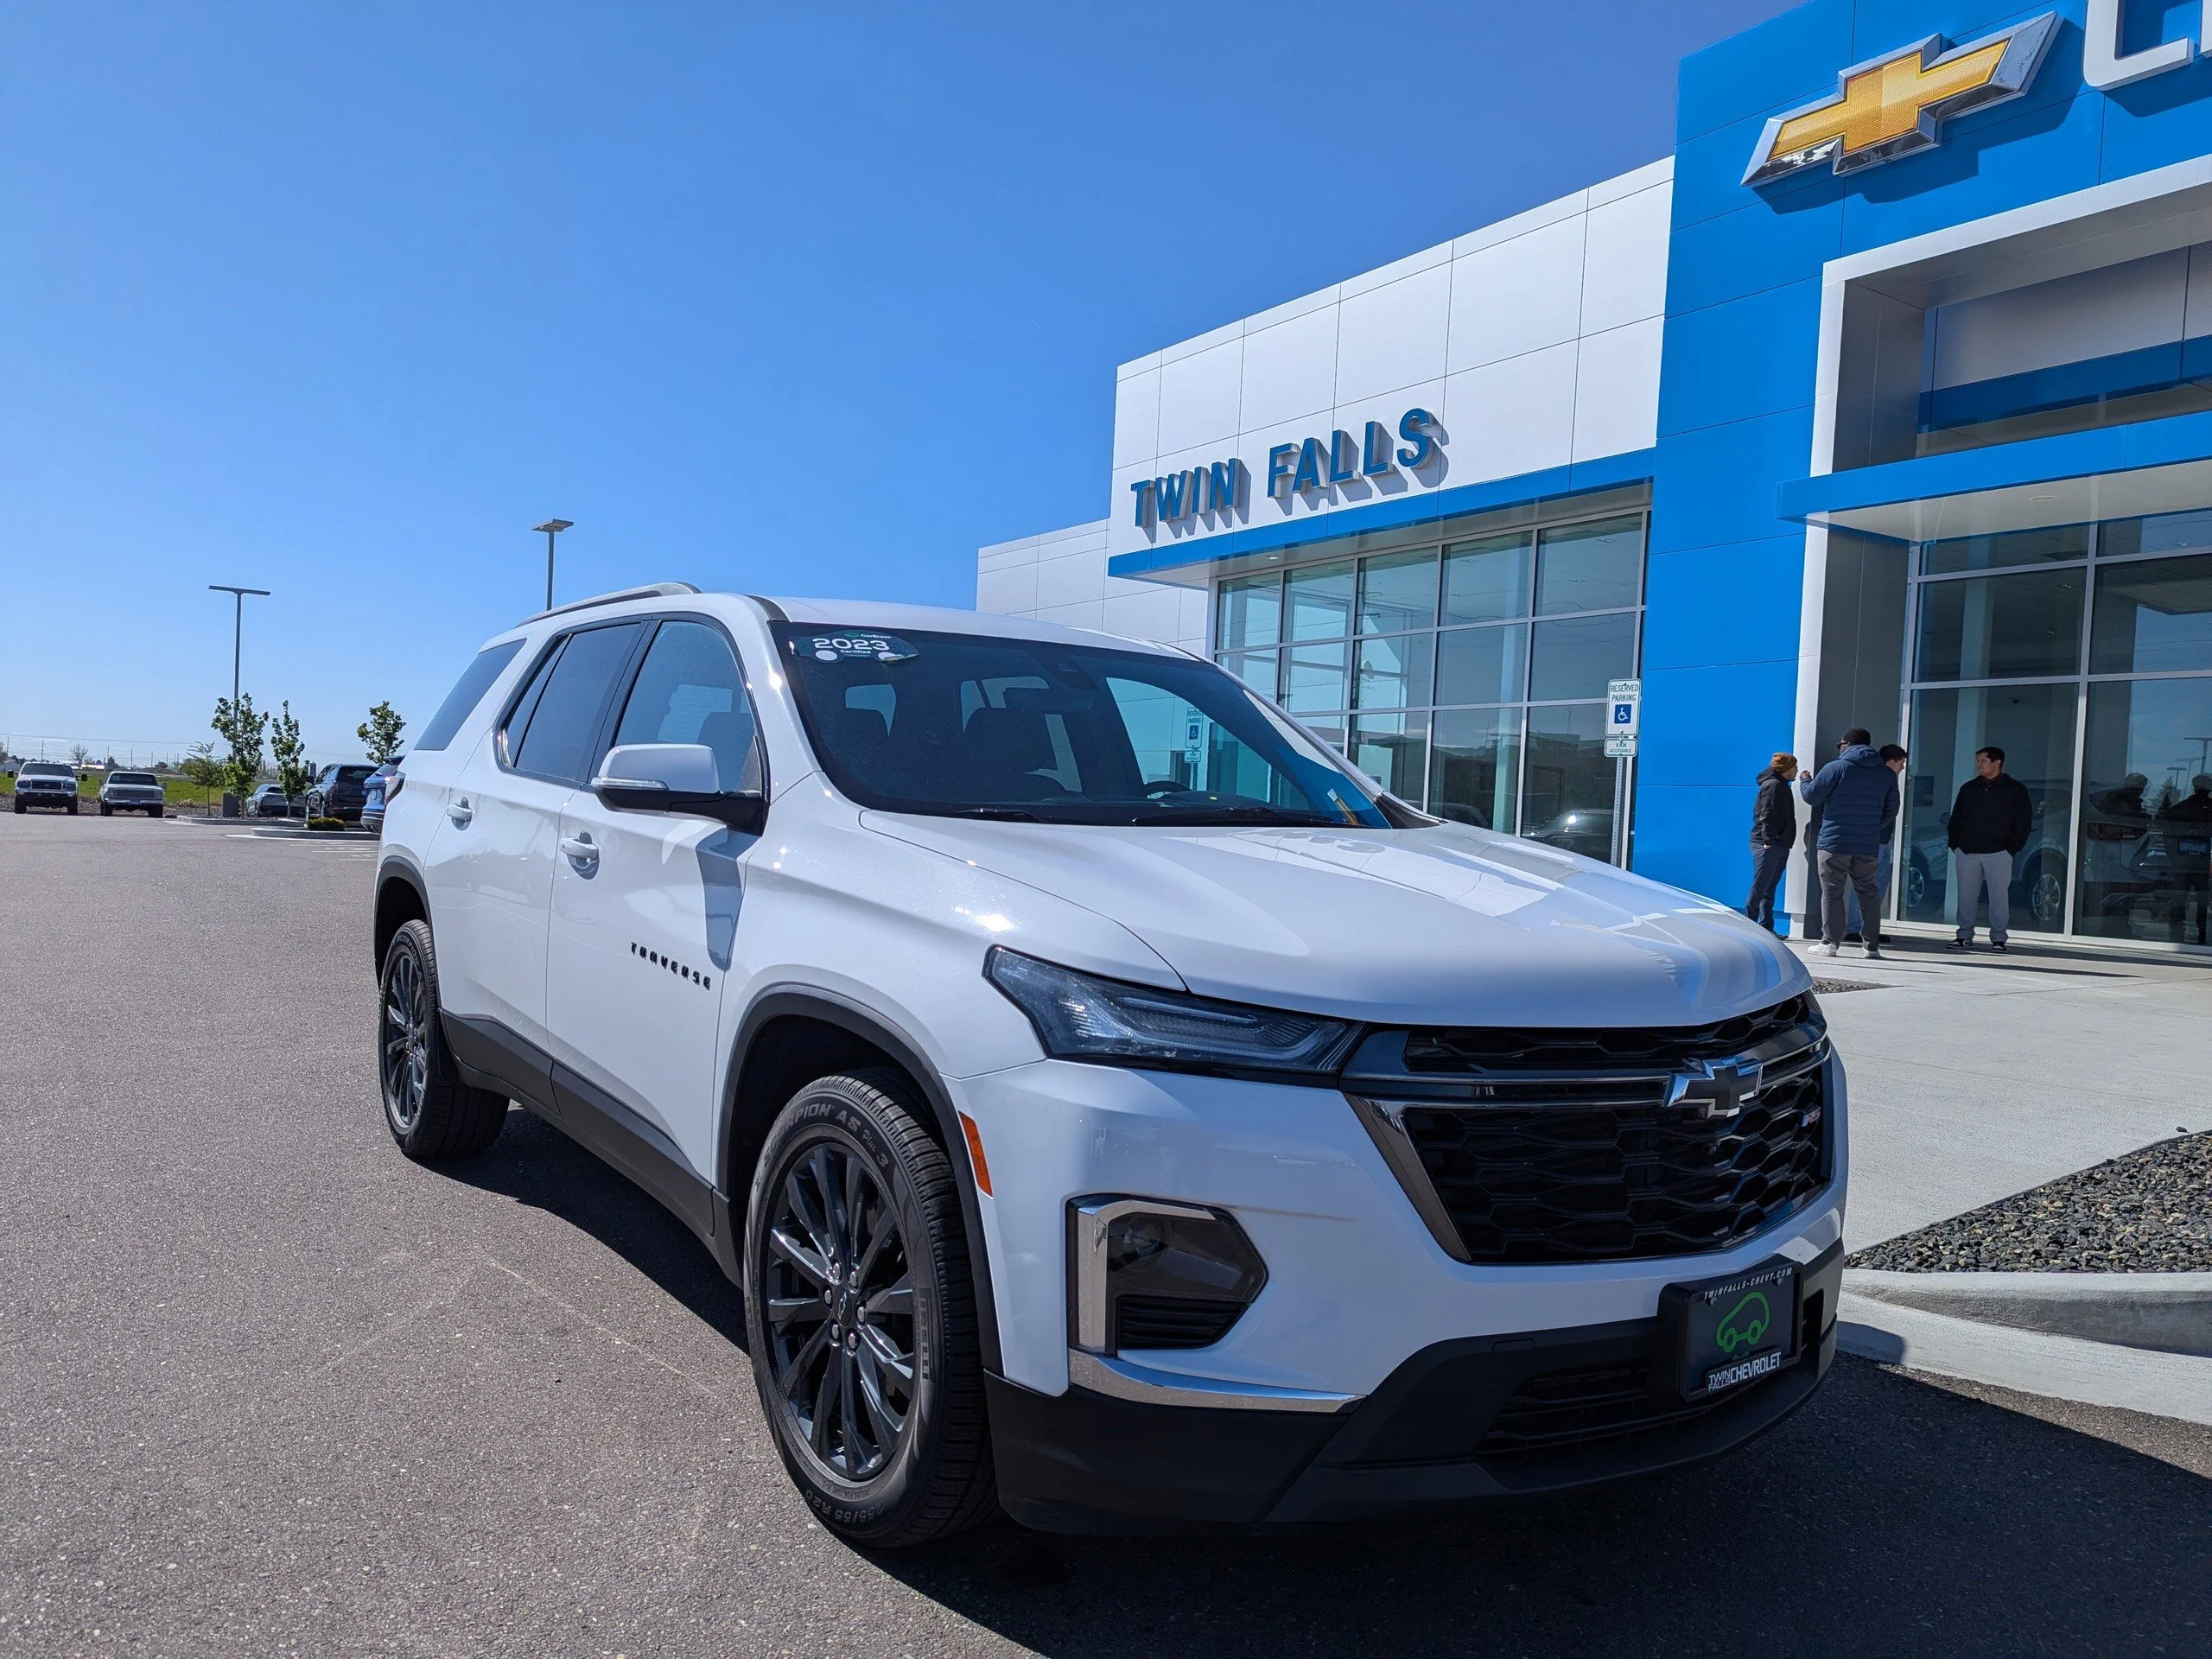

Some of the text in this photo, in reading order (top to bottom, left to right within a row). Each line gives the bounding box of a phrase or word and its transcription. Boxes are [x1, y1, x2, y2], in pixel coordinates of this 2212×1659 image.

[1130, 407, 1434, 529] TWIN FALLS
[812, 638, 890, 651] 2023
[1611, 683, 1639, 693] RESERVED
[1611, 694, 1637, 702] PARKING
[630, 941, 712, 991] TRAVERSE
[1703, 1267, 1793, 1300] TWINFALLS-CHEVY.COM
[1708, 1351, 1782, 1384] TWIN CHEVROLET
[1707, 1377, 1731, 1393] FALLS
